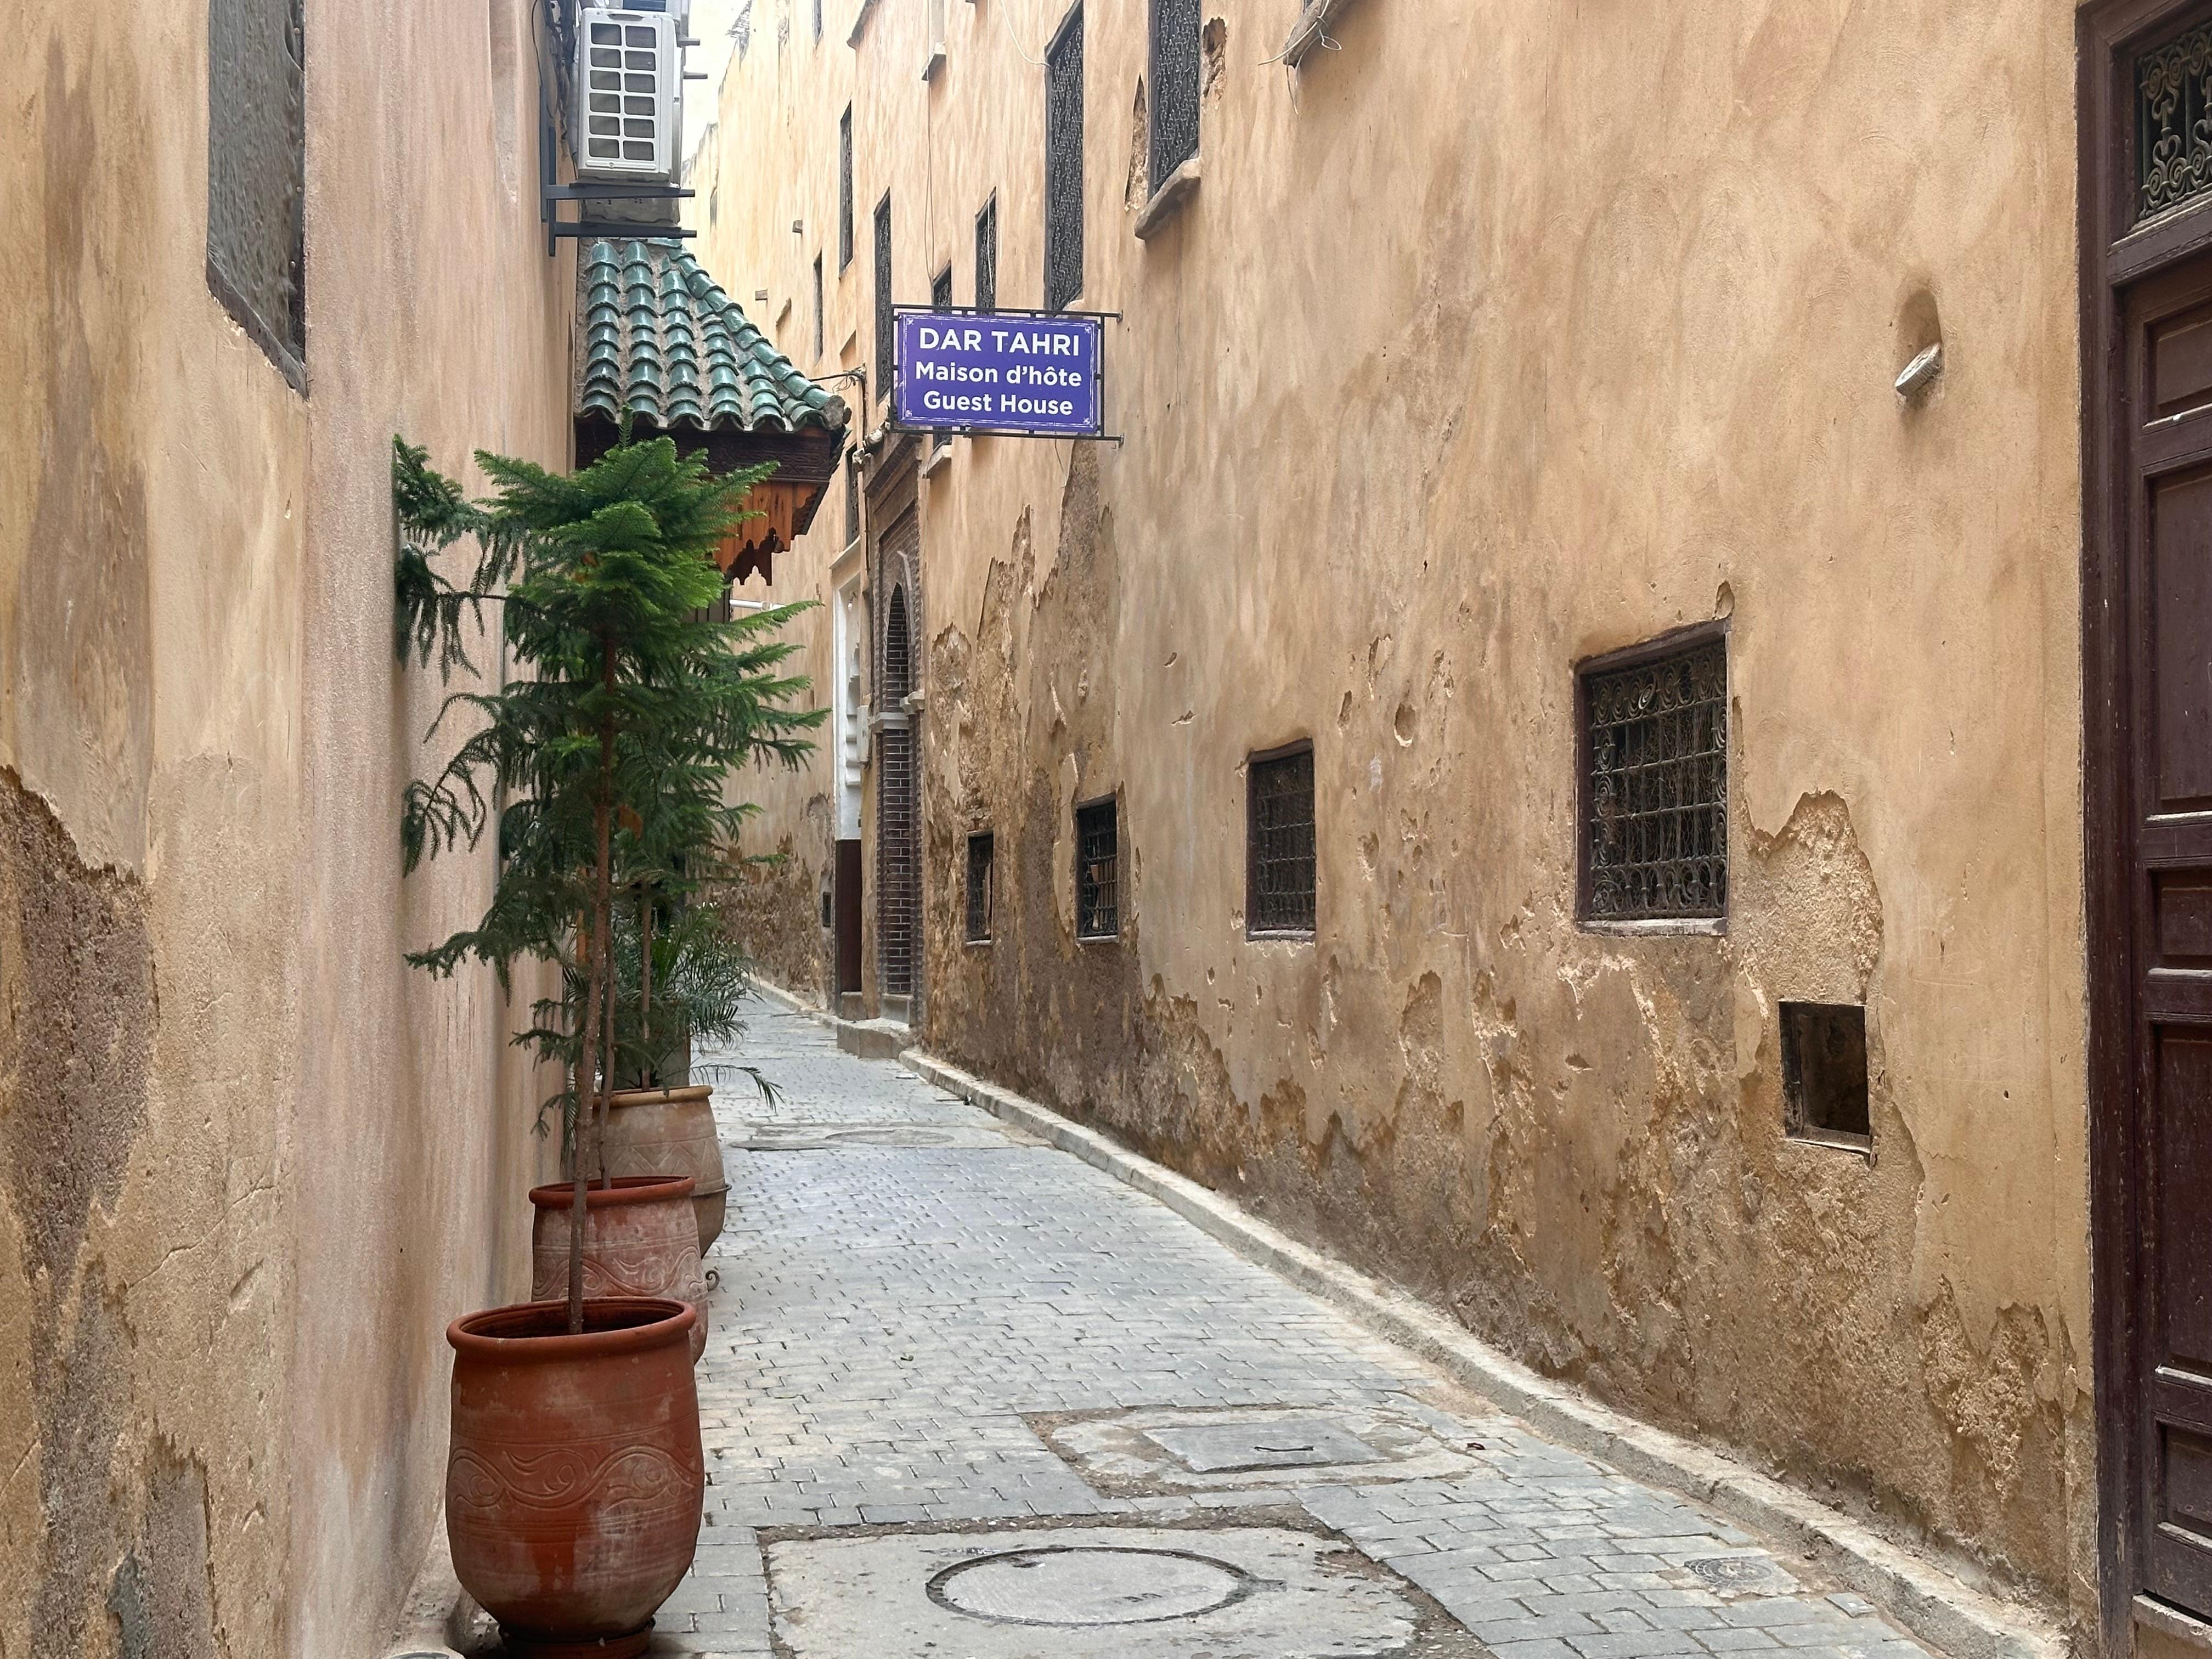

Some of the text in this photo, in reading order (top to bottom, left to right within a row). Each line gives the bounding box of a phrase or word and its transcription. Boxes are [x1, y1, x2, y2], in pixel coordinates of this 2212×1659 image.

[919, 328, 1080, 356] DAR TAHRI
[915, 361, 1082, 387] Maison d'hôte
[923, 390, 1073, 415] Guest House
